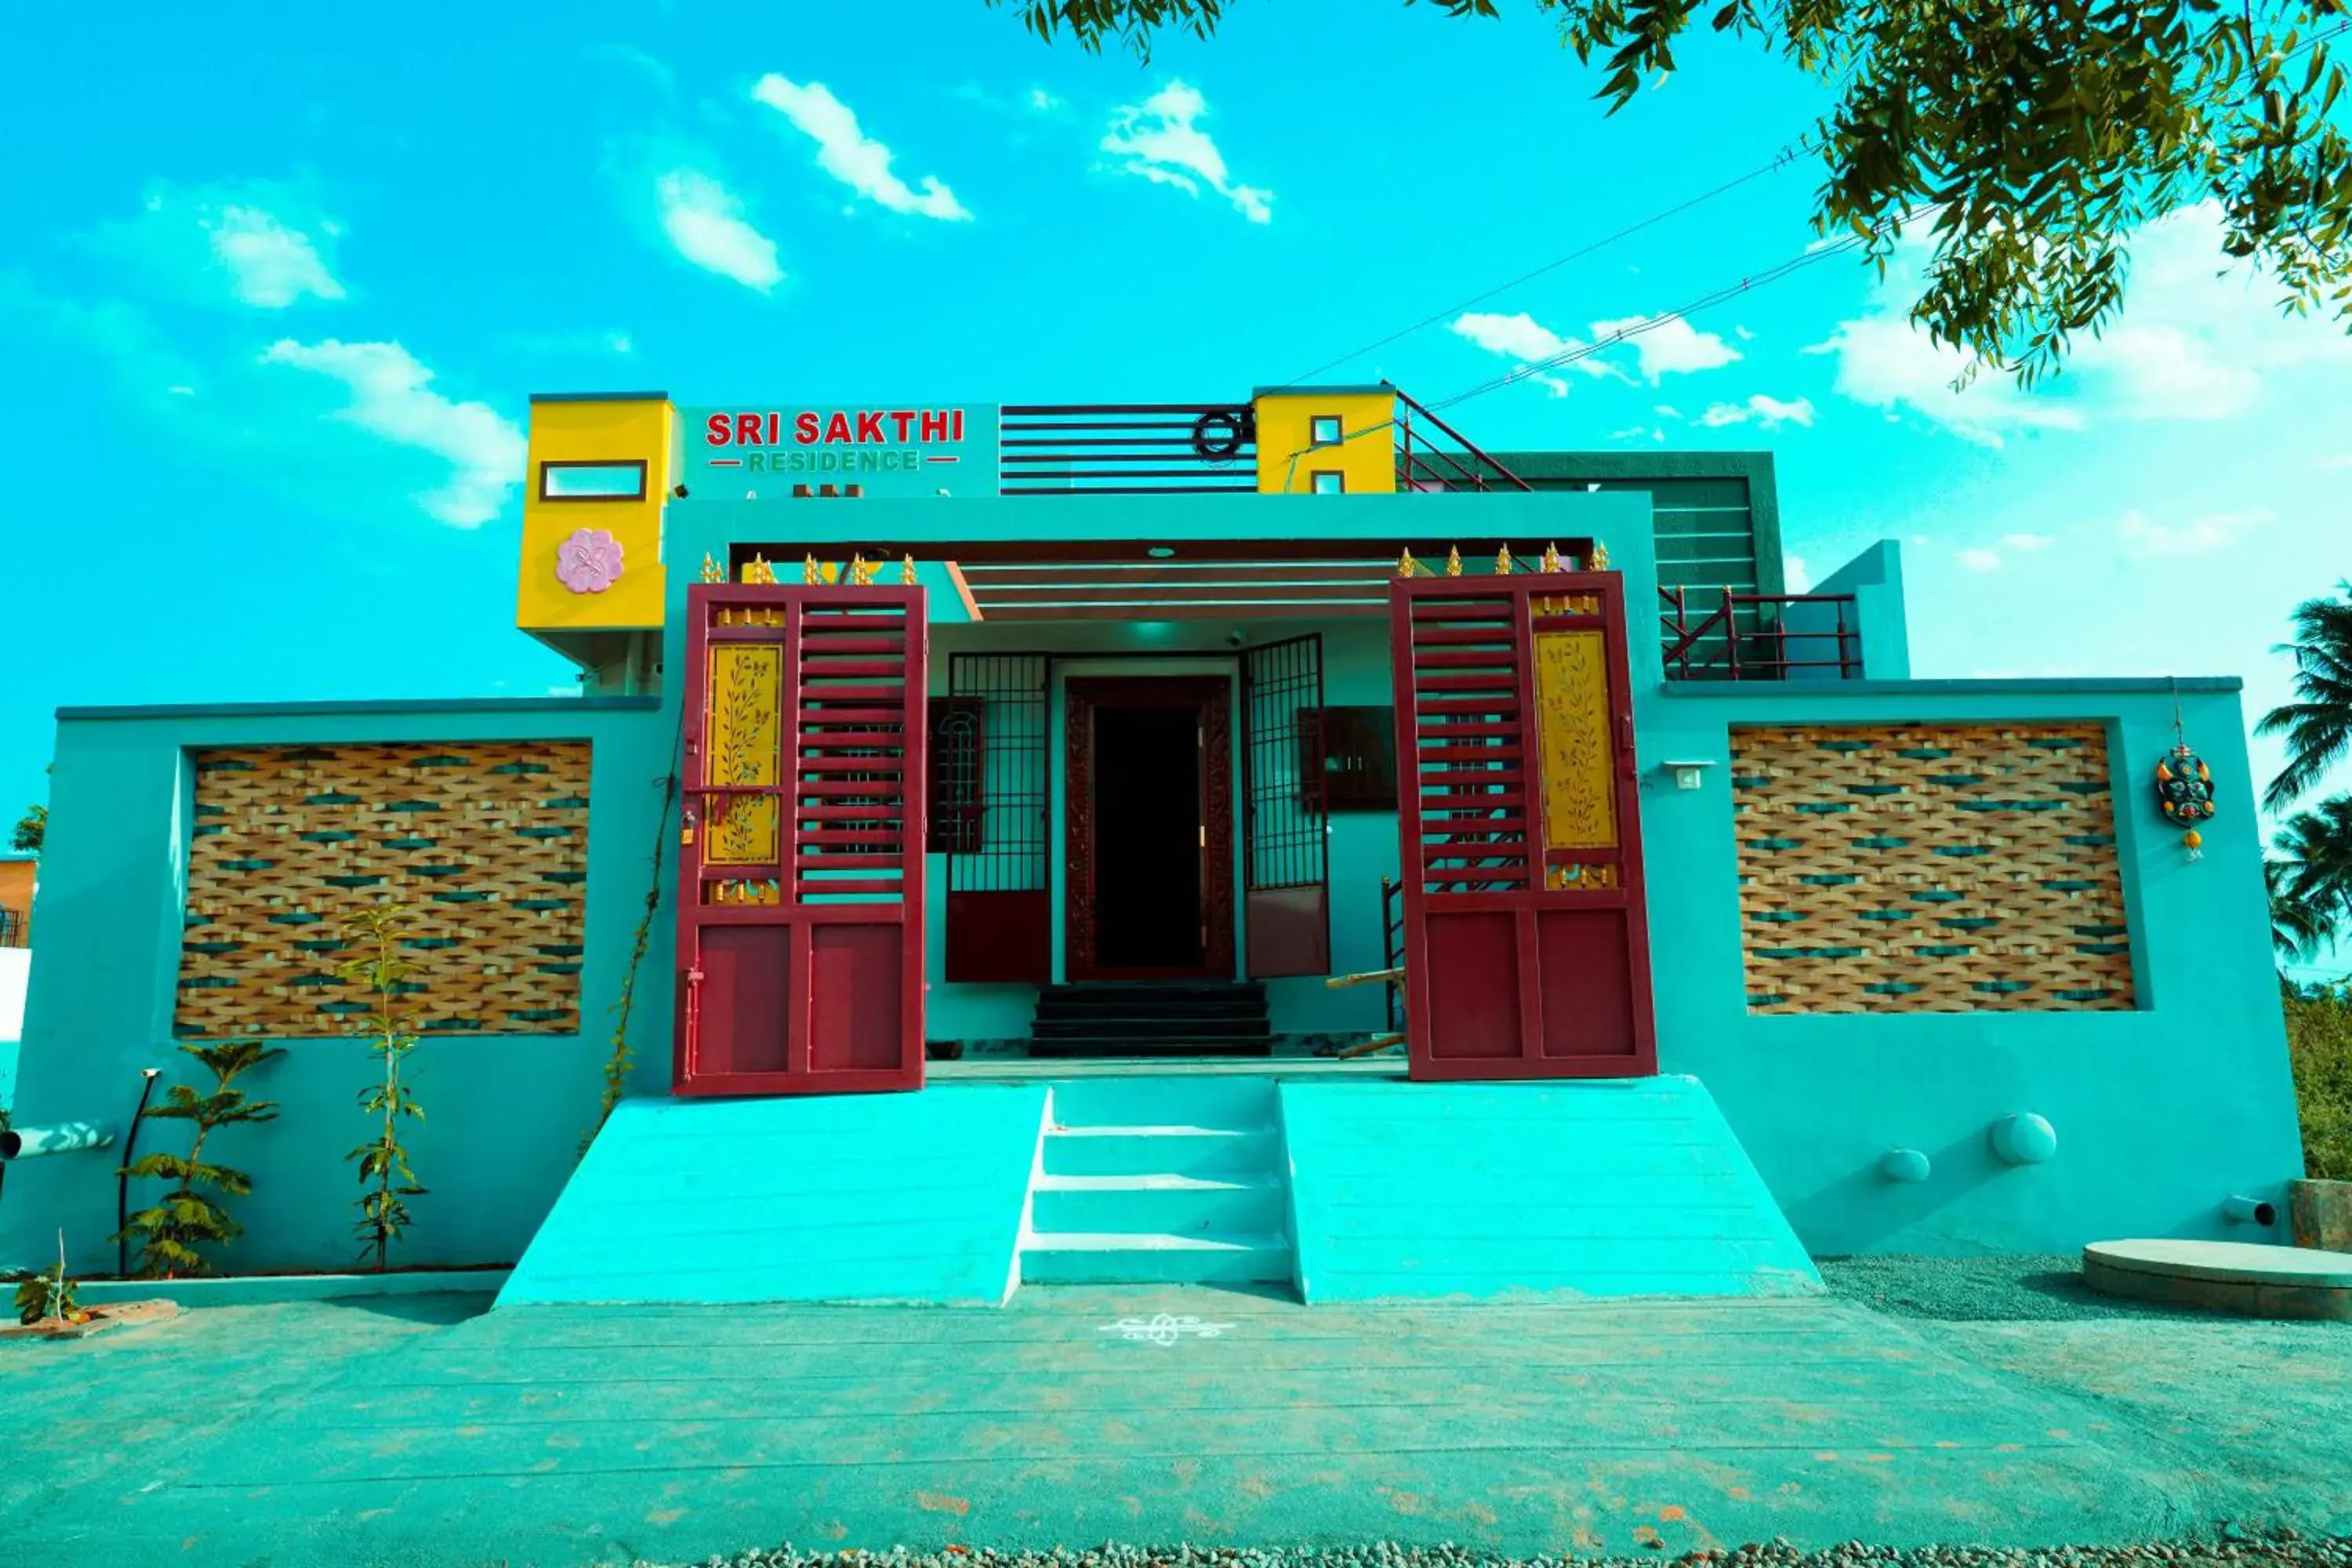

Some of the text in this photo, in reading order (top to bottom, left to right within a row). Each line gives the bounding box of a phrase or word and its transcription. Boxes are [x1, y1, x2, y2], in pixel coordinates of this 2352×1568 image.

[706, 408, 964, 446] SRI SAKTHI
[748, 449, 920, 473] RESIDENCE
